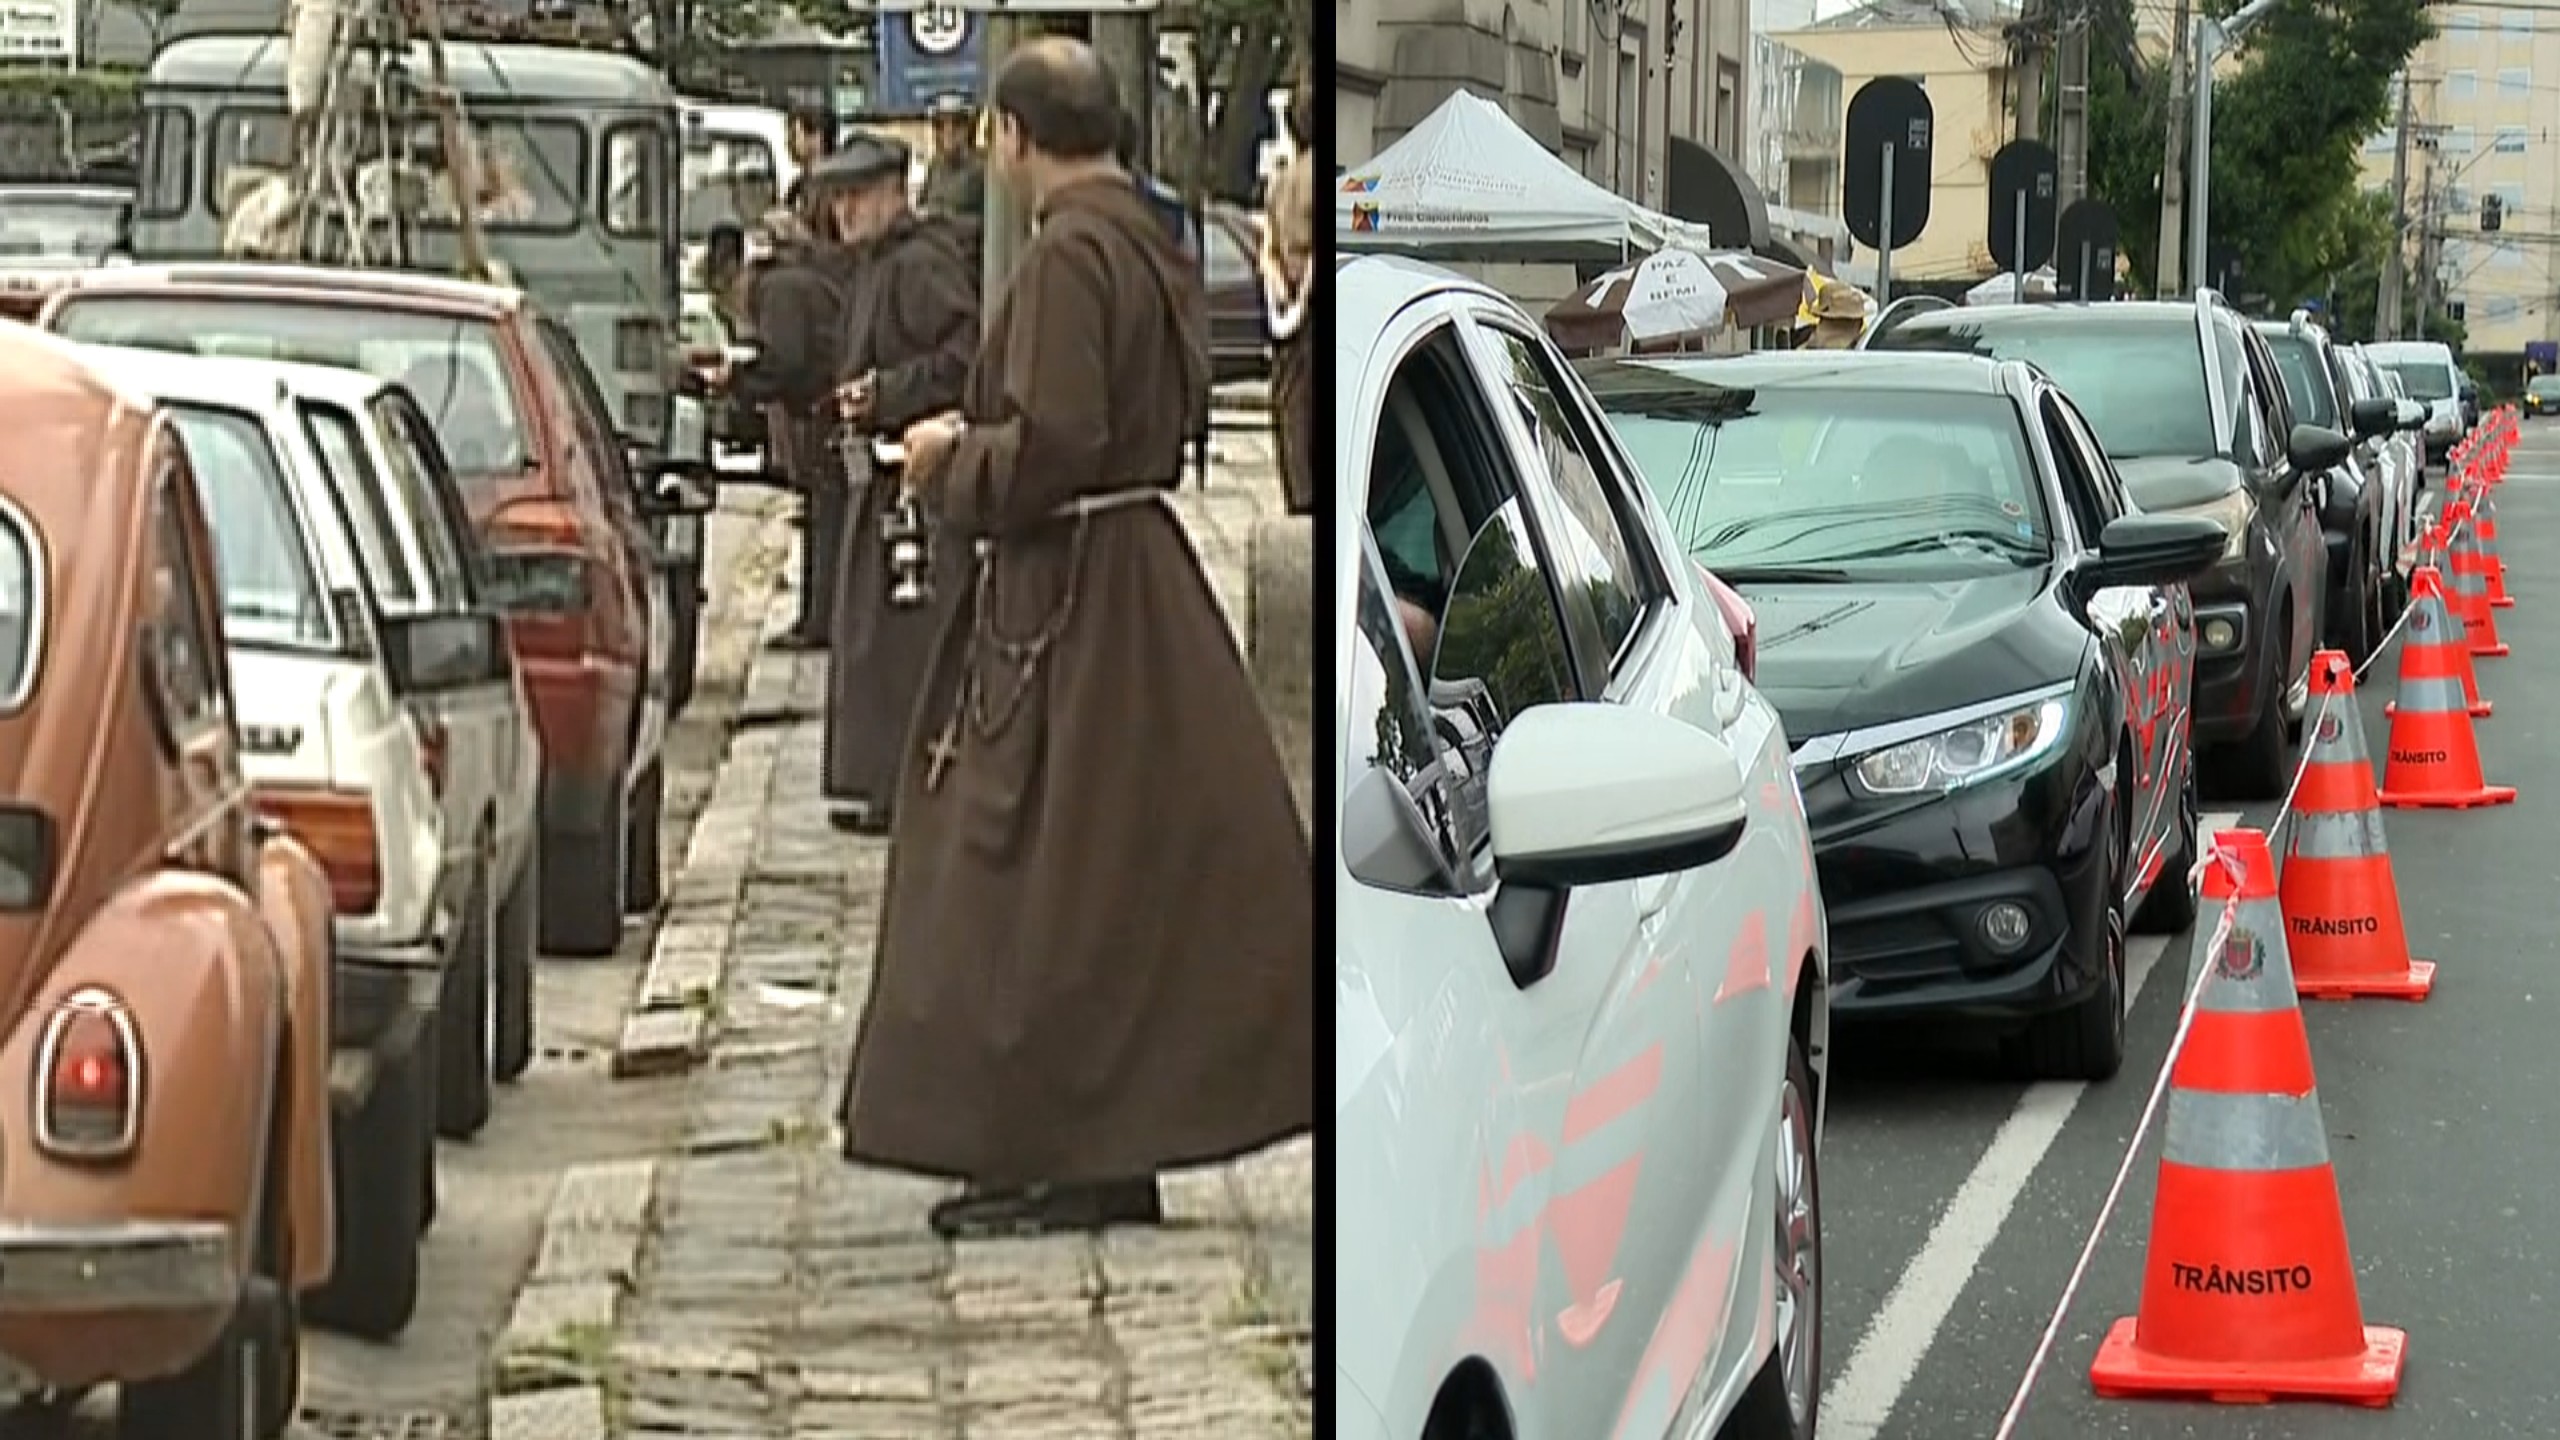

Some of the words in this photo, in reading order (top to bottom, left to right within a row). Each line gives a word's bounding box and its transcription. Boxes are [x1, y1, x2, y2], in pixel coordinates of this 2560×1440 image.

[1650, 258, 1687, 271] PAZ
[1665, 273, 1678, 284] E
[2391, 749, 2447, 764] TRÂNSITO
[2291, 916, 2378, 935] TRÂNSITO
[2171, 1262, 2312, 1295] TRÂNSITO
